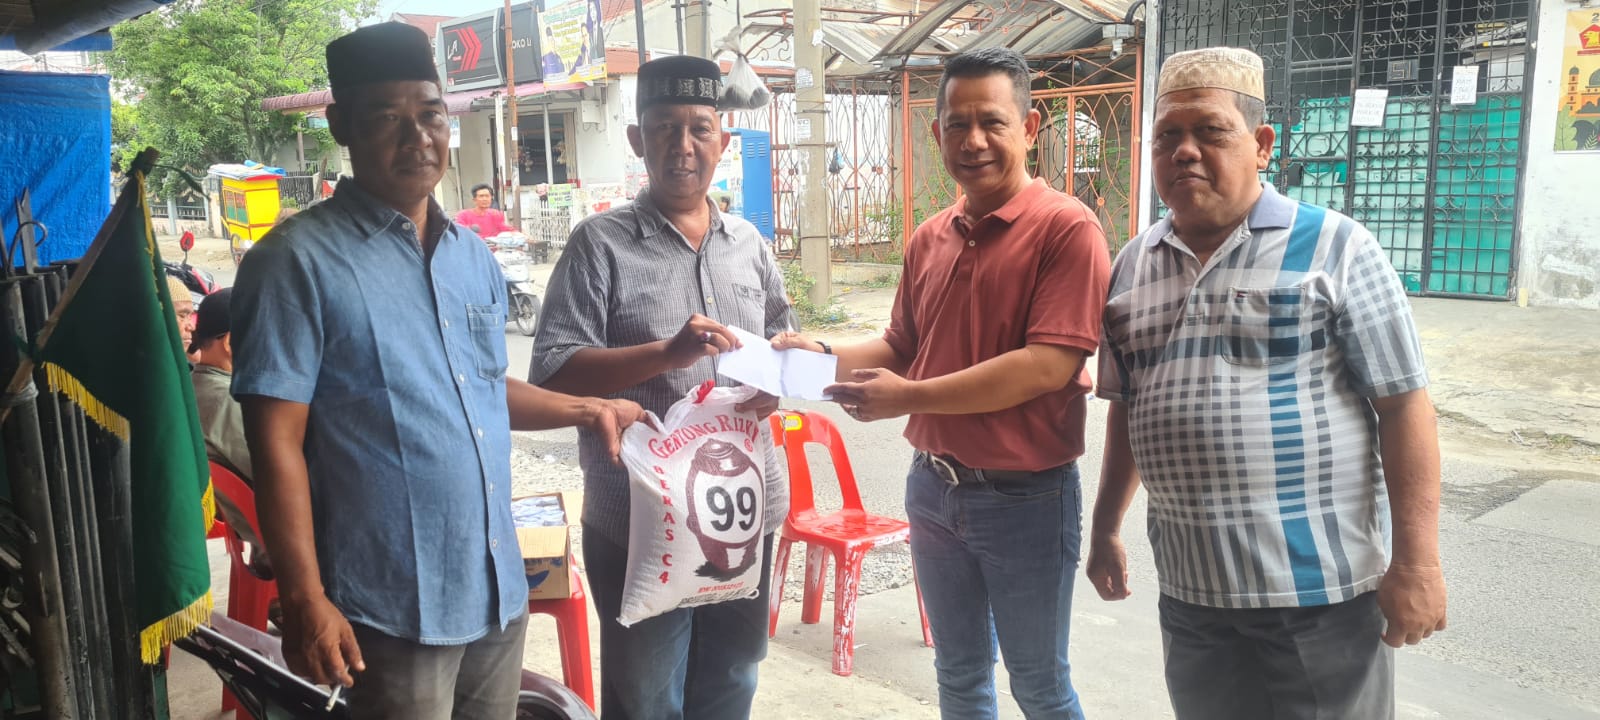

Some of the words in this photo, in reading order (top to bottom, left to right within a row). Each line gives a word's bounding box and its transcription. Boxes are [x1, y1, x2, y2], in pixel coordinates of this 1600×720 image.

[648, 422, 718, 459] GENTONG
[706, 486, 757, 532] 99
[658, 553, 673, 585] C4
